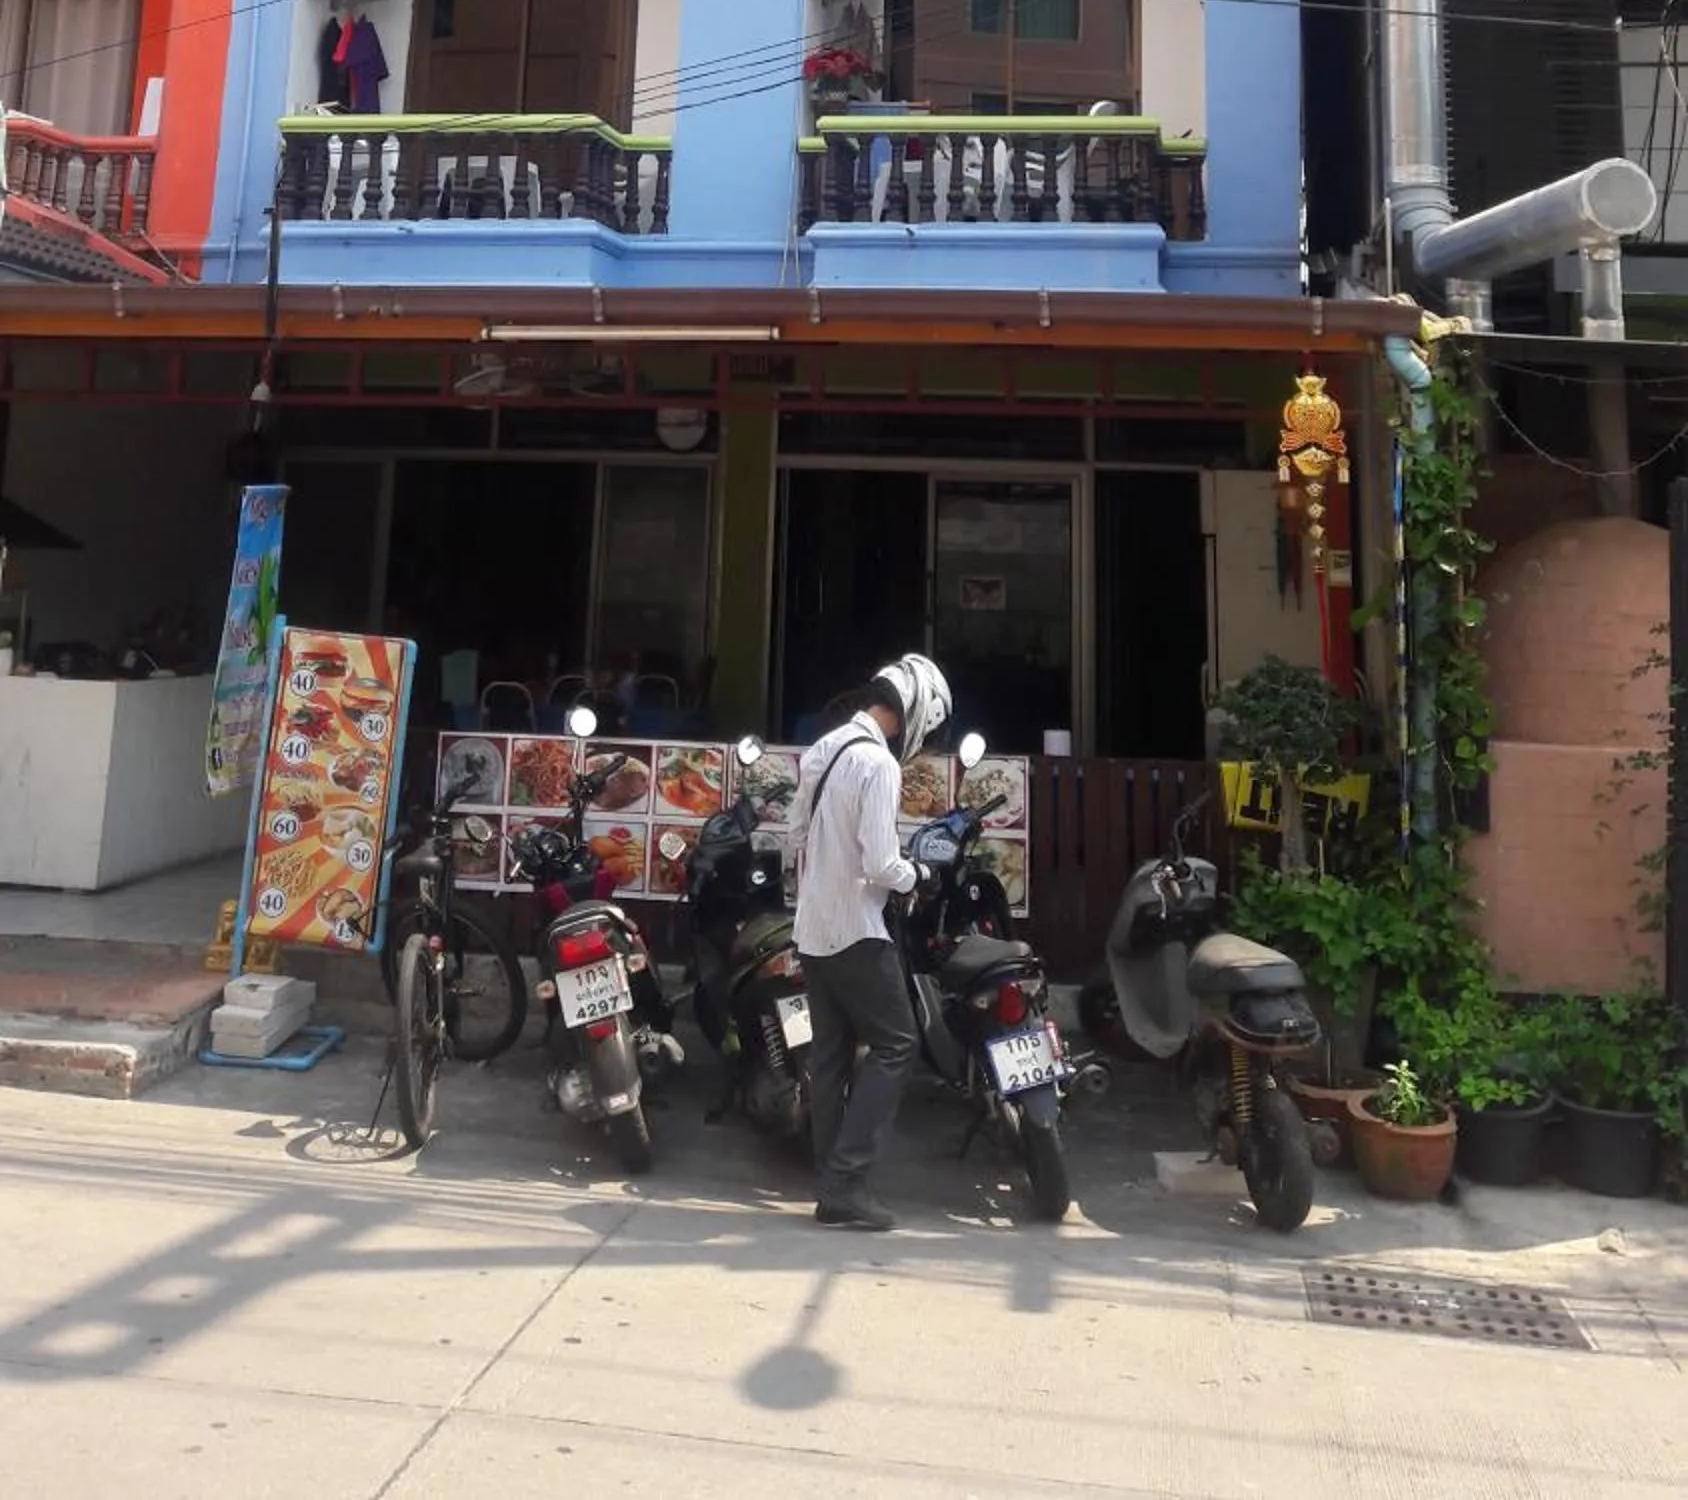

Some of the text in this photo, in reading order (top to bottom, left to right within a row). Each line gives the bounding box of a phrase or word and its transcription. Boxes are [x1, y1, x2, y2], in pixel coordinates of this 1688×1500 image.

[293, 673, 314, 691] 40
[365, 720, 384, 735] 30
[283, 741, 307, 759] 40
[273, 819, 297, 835] 60
[351, 847, 370, 863] 30
[262, 894, 283, 911] 40
[575, 996, 619, 1019] 4297
[1008, 1063, 1055, 1088] 2104
